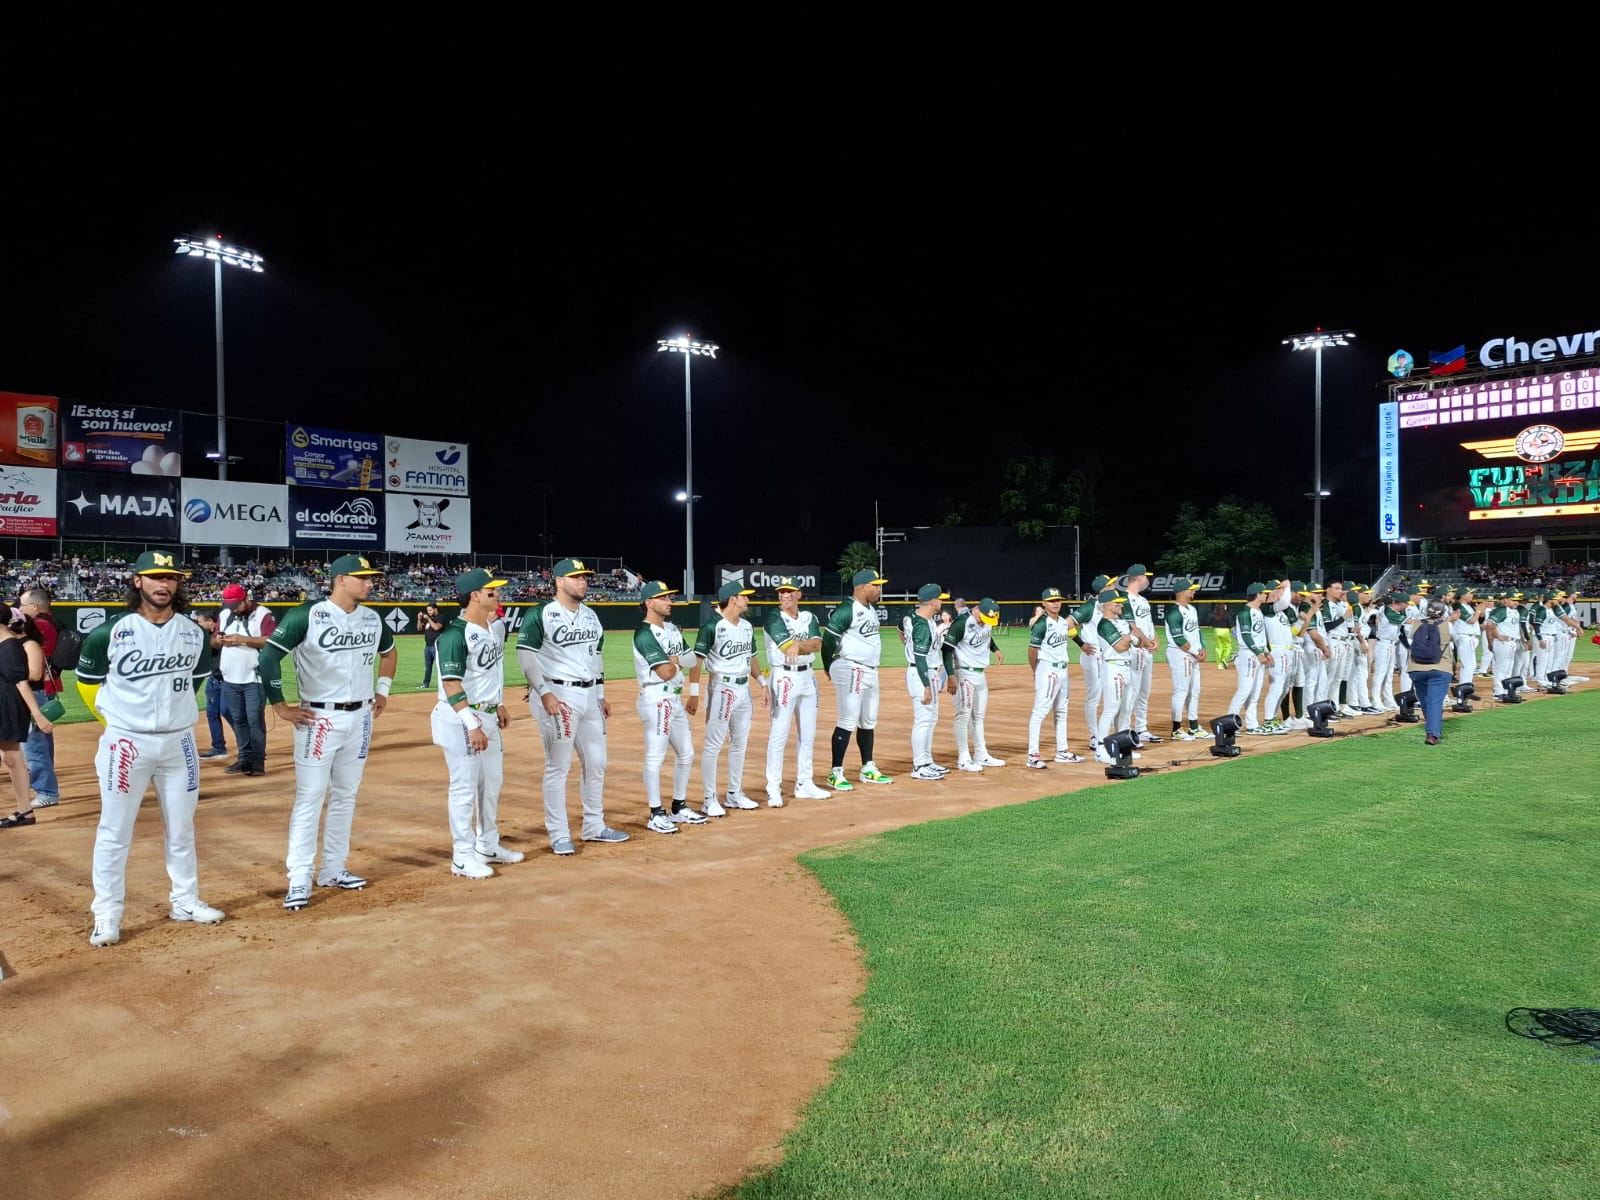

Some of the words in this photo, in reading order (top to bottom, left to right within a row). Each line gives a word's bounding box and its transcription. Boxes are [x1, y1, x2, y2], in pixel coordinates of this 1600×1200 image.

[1565, 383, 1571, 392] 0
[1582, 380, 1588, 389] 0
[1565, 398, 1571, 407] 0
[1582, 397, 1588, 405] 0
[71, 405, 119, 418] ¡Estos
[122, 408, 136, 419] sí
[81, 420, 110, 429] son
[113, 419, 172, 431] huevos!
[310, 434, 378, 452] Smartgas
[406, 471, 465, 486] FATIMA
[100, 494, 174, 517] MAJA
[214, 502, 282, 522] MEGA
[296, 508, 309, 522] el
[312, 508, 377, 525] colorado
[363, 653, 373, 665] 72
